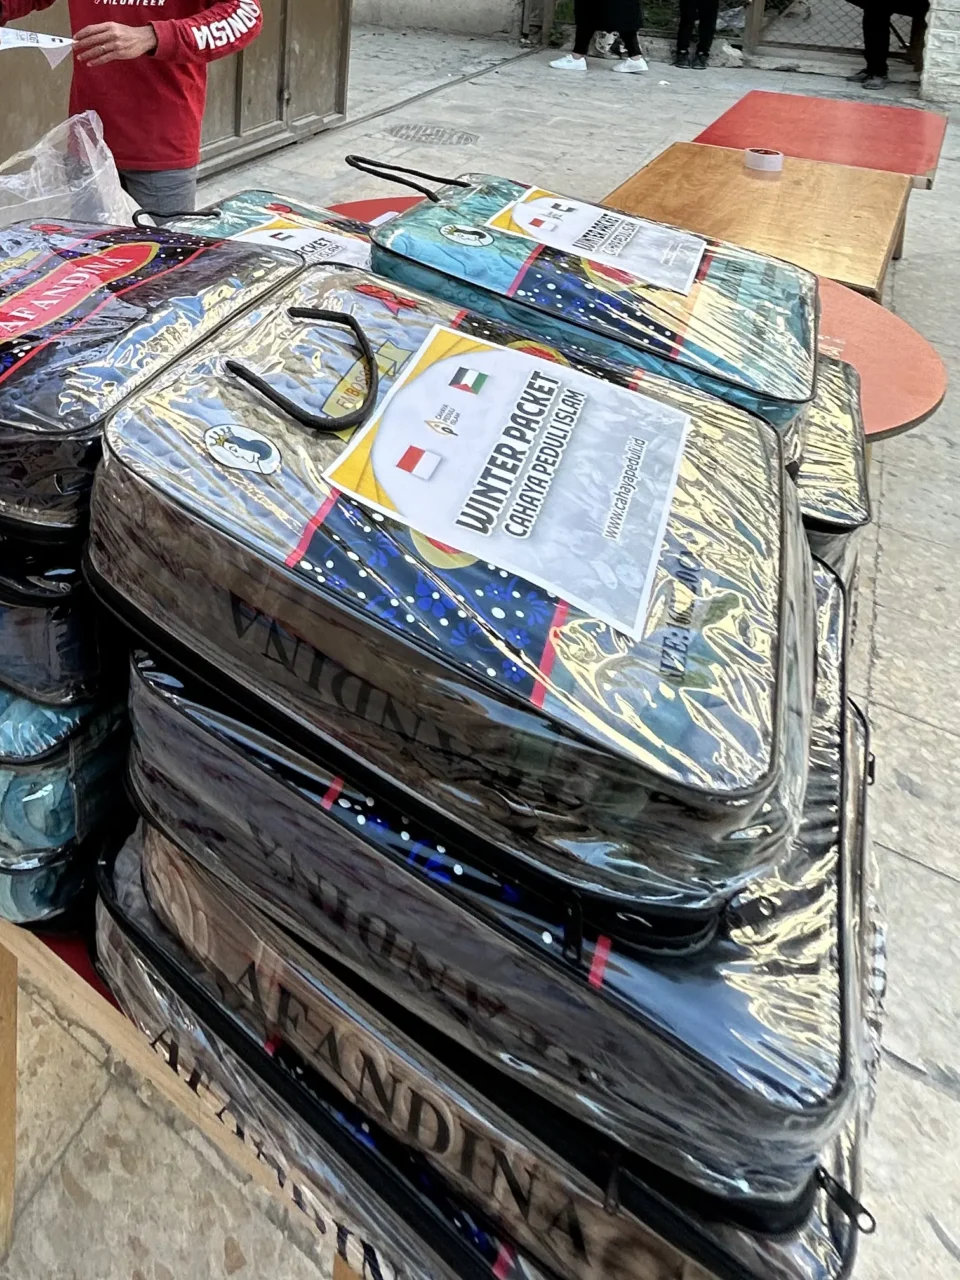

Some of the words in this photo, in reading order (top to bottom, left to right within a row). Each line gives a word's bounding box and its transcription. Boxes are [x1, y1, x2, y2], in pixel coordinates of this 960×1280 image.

[295, 237, 332, 255] ACKET
[455, 442, 527, 534] WINTER
[502, 370, 560, 445] PACKET
[504, 475, 549, 537] CAHAYA
[531, 424, 570, 476] PEDULI
[555, 389, 586, 427] ISLAM
[604, 437, 645, 539] www.cahayapeduli.id
[229, 589, 472, 757] ANDINA
[236, 960, 592, 1268] AFANDINA
